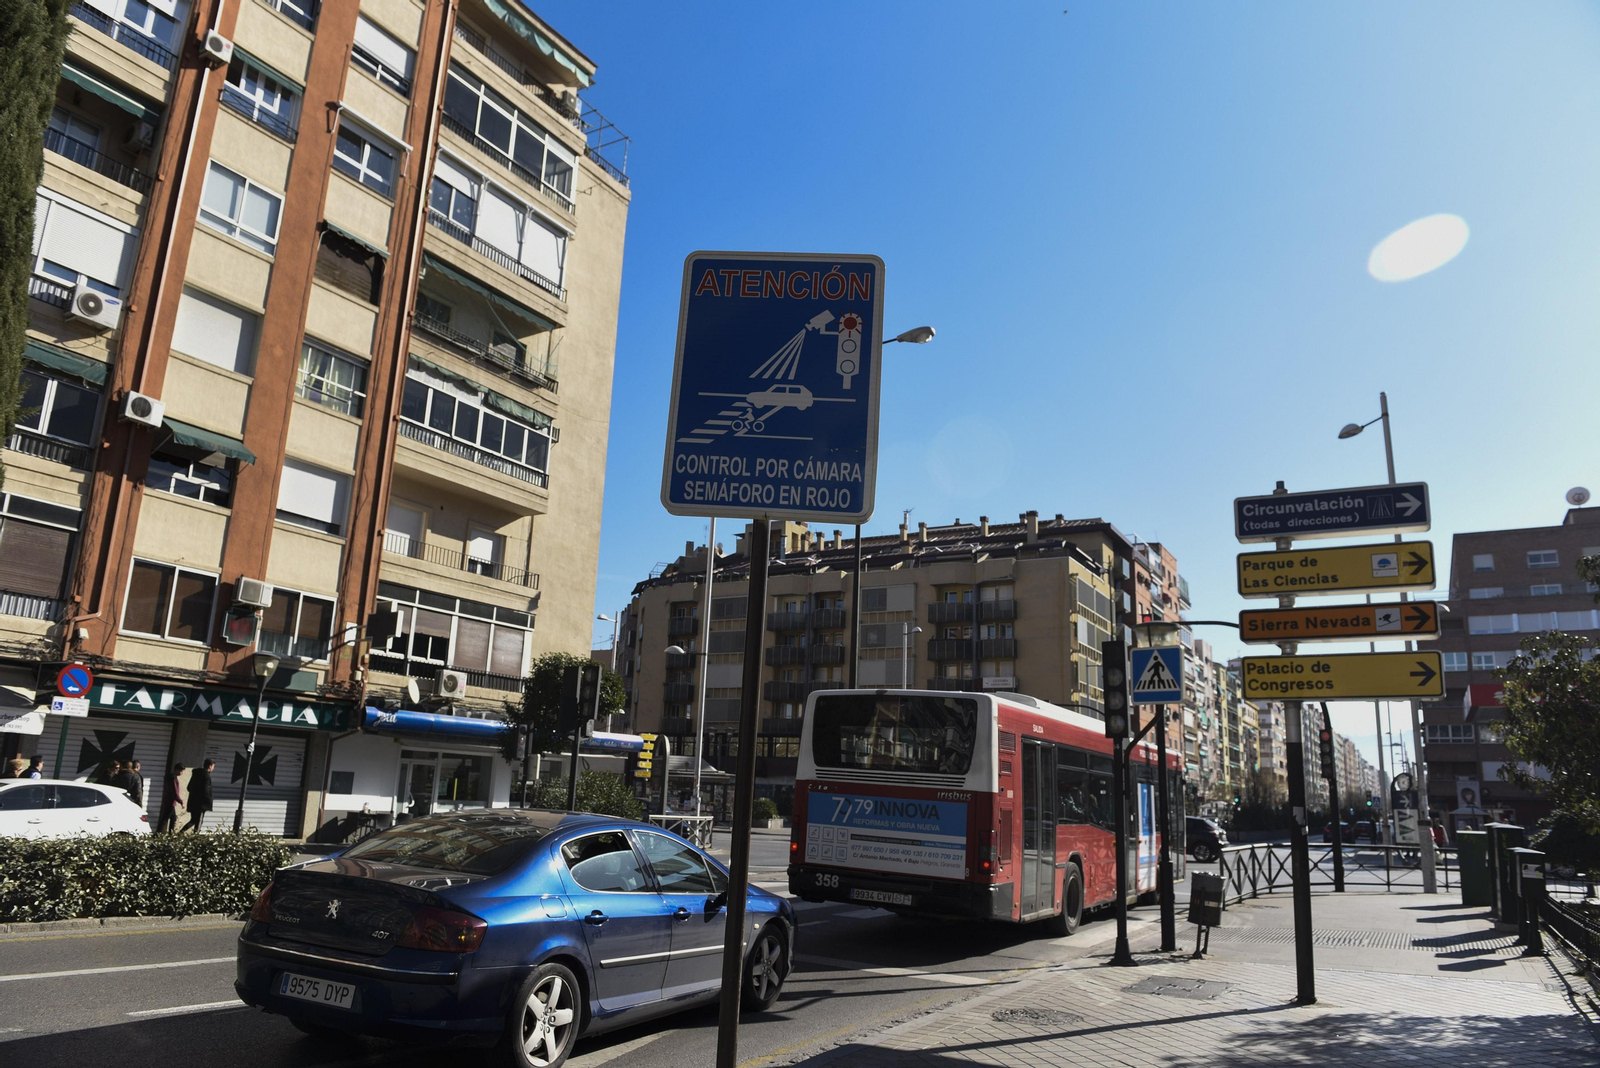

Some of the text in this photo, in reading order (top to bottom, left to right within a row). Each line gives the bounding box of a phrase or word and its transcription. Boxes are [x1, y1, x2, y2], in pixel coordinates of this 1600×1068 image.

[695, 265, 870, 300] ATENCIÓN
[676, 454, 862, 482] CONTROL POR CÁMARA
[684, 479, 850, 509] SEMÁFORO EN ROJO
[1242, 496, 1364, 517] Circunvalación
[1243, 512, 1360, 532] (todas direcciones)
[1243, 557, 1318, 572] Parque de
[1244, 572, 1339, 588] Las Ciencias
[1248, 615, 1371, 632] Sierra Nevada
[1246, 661, 1331, 675] Palacio de
[1248, 678, 1334, 693] Congresos
[100, 682, 319, 724] FARMACIA
[937, 791, 972, 801] irisbus
[853, 818, 889, 828] REFORMAS
[815, 873, 839, 888] 358
[855, 890, 874, 900] 9934
[275, 914, 300, 925] PEUGEOT
[371, 930, 390, 941] 407
[290, 977, 349, 1003] 9575 DYP
